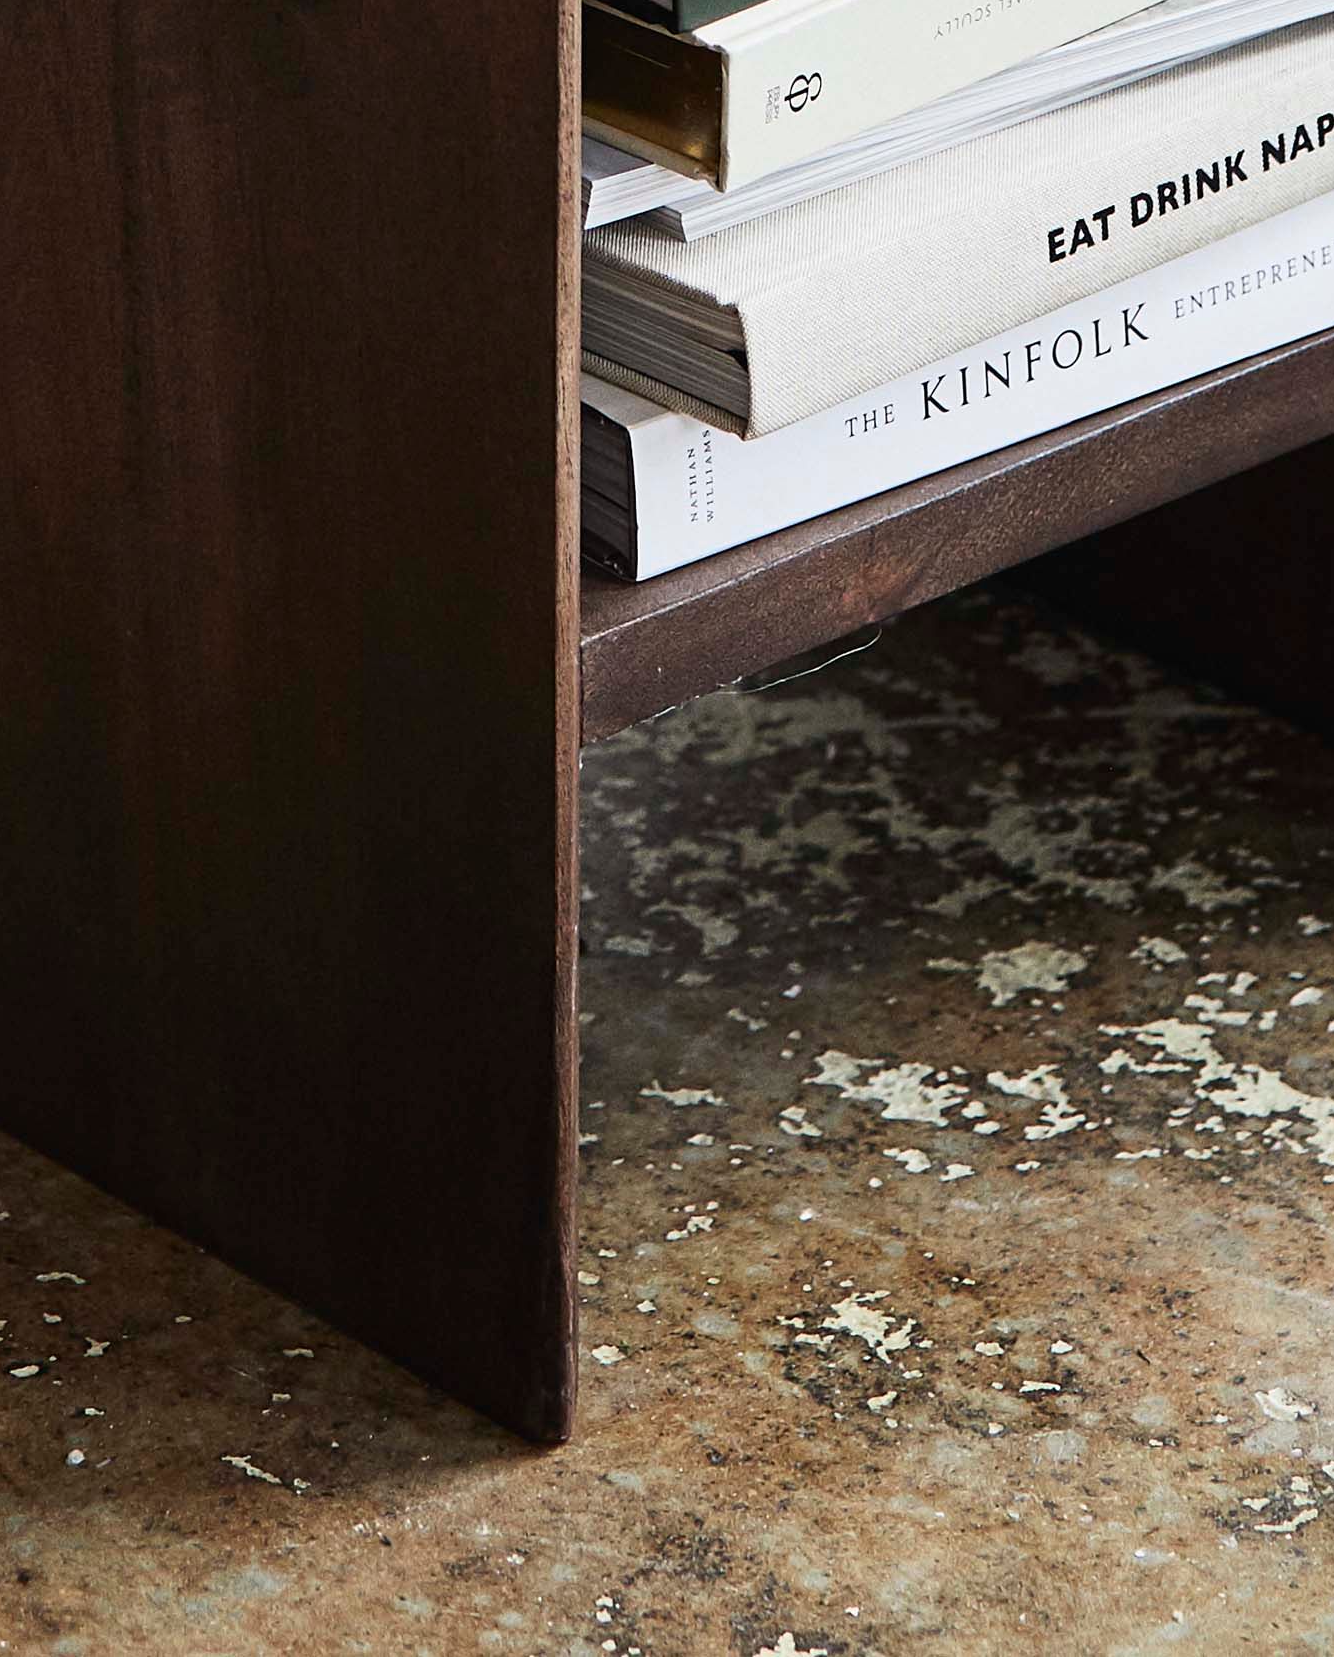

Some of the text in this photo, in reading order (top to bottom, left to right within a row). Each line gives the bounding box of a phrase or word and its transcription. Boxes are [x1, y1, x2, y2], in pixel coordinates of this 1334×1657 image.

[933, 2, 994, 41] SCULLY
[1047, 204, 1115, 264] EAT
[1130, 149, 1249, 229] DRINK
[845, 403, 896, 438] THE
[919, 302, 1150, 421] KINFOLK
[687, 446, 699, 523] NATHAN
[701, 429, 715, 523] WILLIAMS
